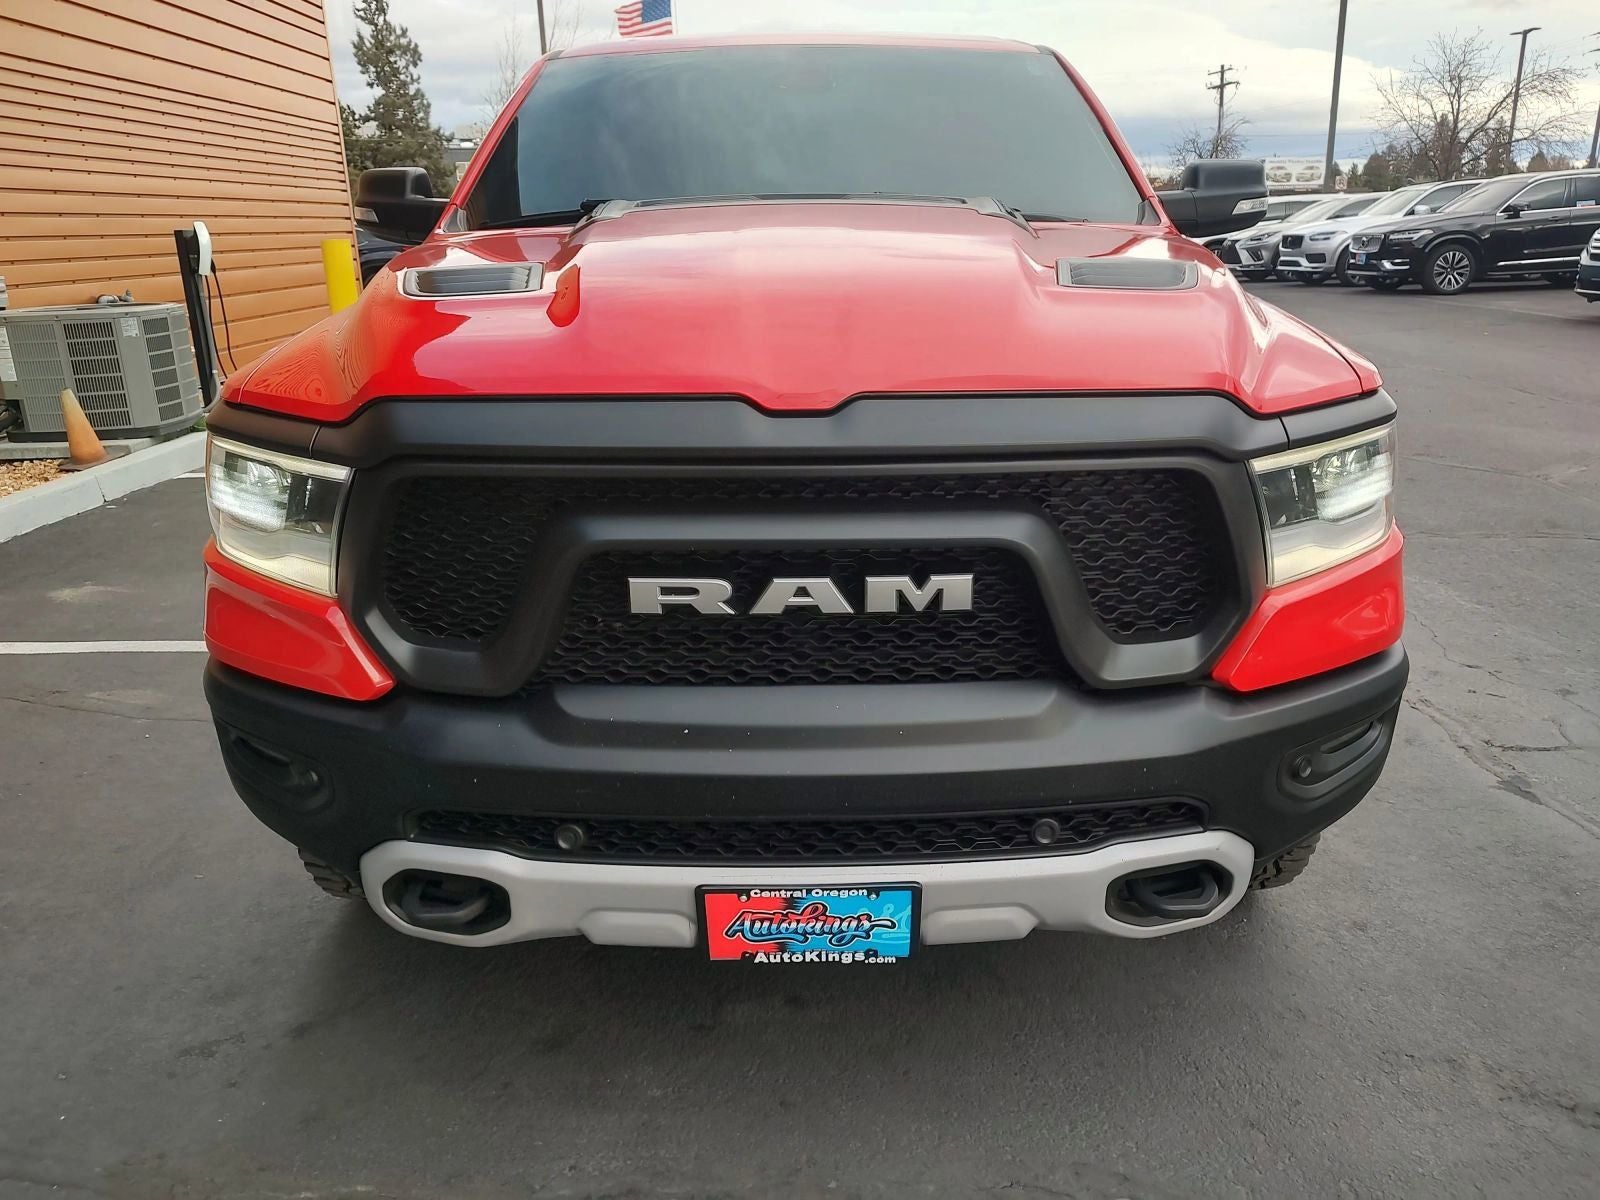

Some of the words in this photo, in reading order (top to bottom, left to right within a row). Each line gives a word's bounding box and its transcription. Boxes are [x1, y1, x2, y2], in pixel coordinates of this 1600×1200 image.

[628, 574, 974, 615] RAM
[750, 889, 807, 898] Central
[811, 888, 868, 898] Oregon
[753, 951, 897, 965] AutoKings.com
